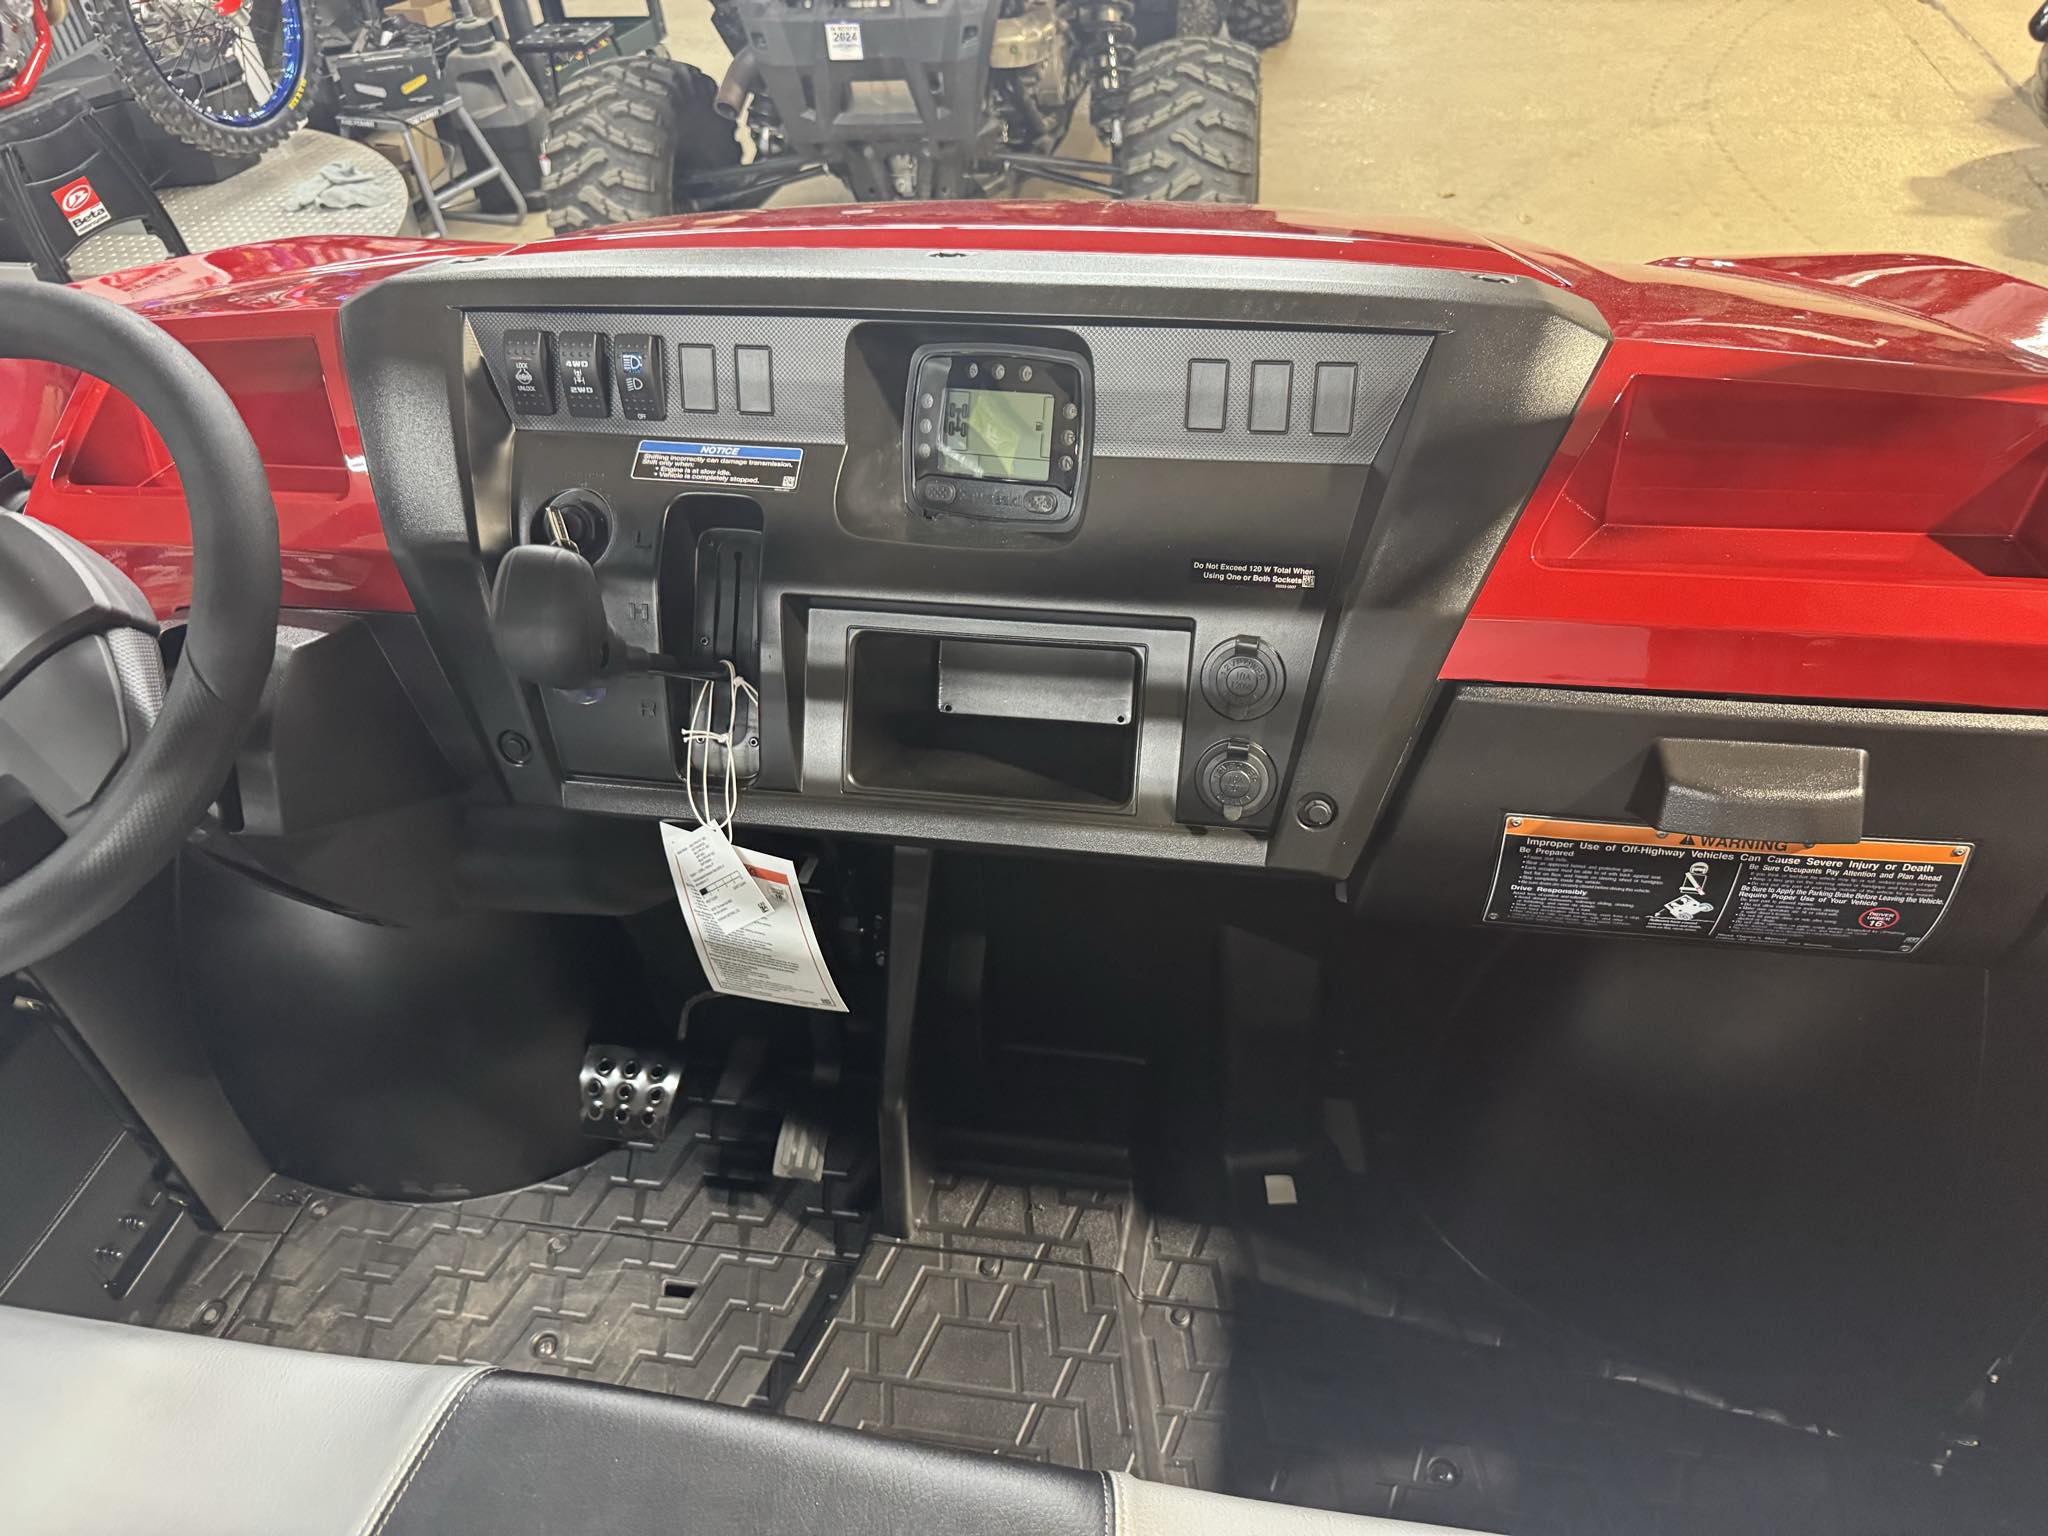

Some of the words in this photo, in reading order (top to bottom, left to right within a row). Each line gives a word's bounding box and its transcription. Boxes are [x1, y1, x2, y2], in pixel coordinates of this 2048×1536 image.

[73, 208, 105, 227] Beta
[566, 360, 588, 368] 4WD
[700, 446, 740, 456] NOTICE
[670, 455, 705, 464] incorrectly
[749, 460, 793, 468] transmission.
[692, 474, 729, 482] completely
[1206, 562, 1218, 570] Not
[1220, 563, 1247, 572] Exceed
[1273, 566, 1291, 574] Total
[1293, 567, 1314, 575] When
[1203, 572, 1224, 581] Using
[1272, 576, 1302, 584] Sockets
[1701, 836, 1788, 851] WARNING
[1526, 838, 1574, 848] Improper
[1580, 842, 1600, 851] Use
[1605, 844, 1616, 852] of
[1622, 845, 1685, 858] Off-Highway
[1691, 850, 1734, 860] Vehicles
[1740, 854, 1760, 862] Can
[1767, 855, 1800, 865] Cause
[1806, 858, 1843, 868] Severe
[1849, 860, 1880, 871] Injury
[1902, 864, 1935, 872] Death
[1536, 848, 1575, 857] Prepared
[1762, 864, 1780, 872] Sure
[1783, 866, 1822, 874] Occupants
[1826, 868, 1840, 876] Pay
[1843, 870, 1876, 878] Attention
[1511, 884, 1532, 892] Drive
[1536, 886, 1588, 896] Responsibly
[1739, 891, 1768, 899] Require
[1808, 889, 1833, 898] Parking
[1834, 891, 1854, 899] Brake
[1878, 895, 1905, 903] Leaving
[1919, 897, 1944, 905] Vehicle.
